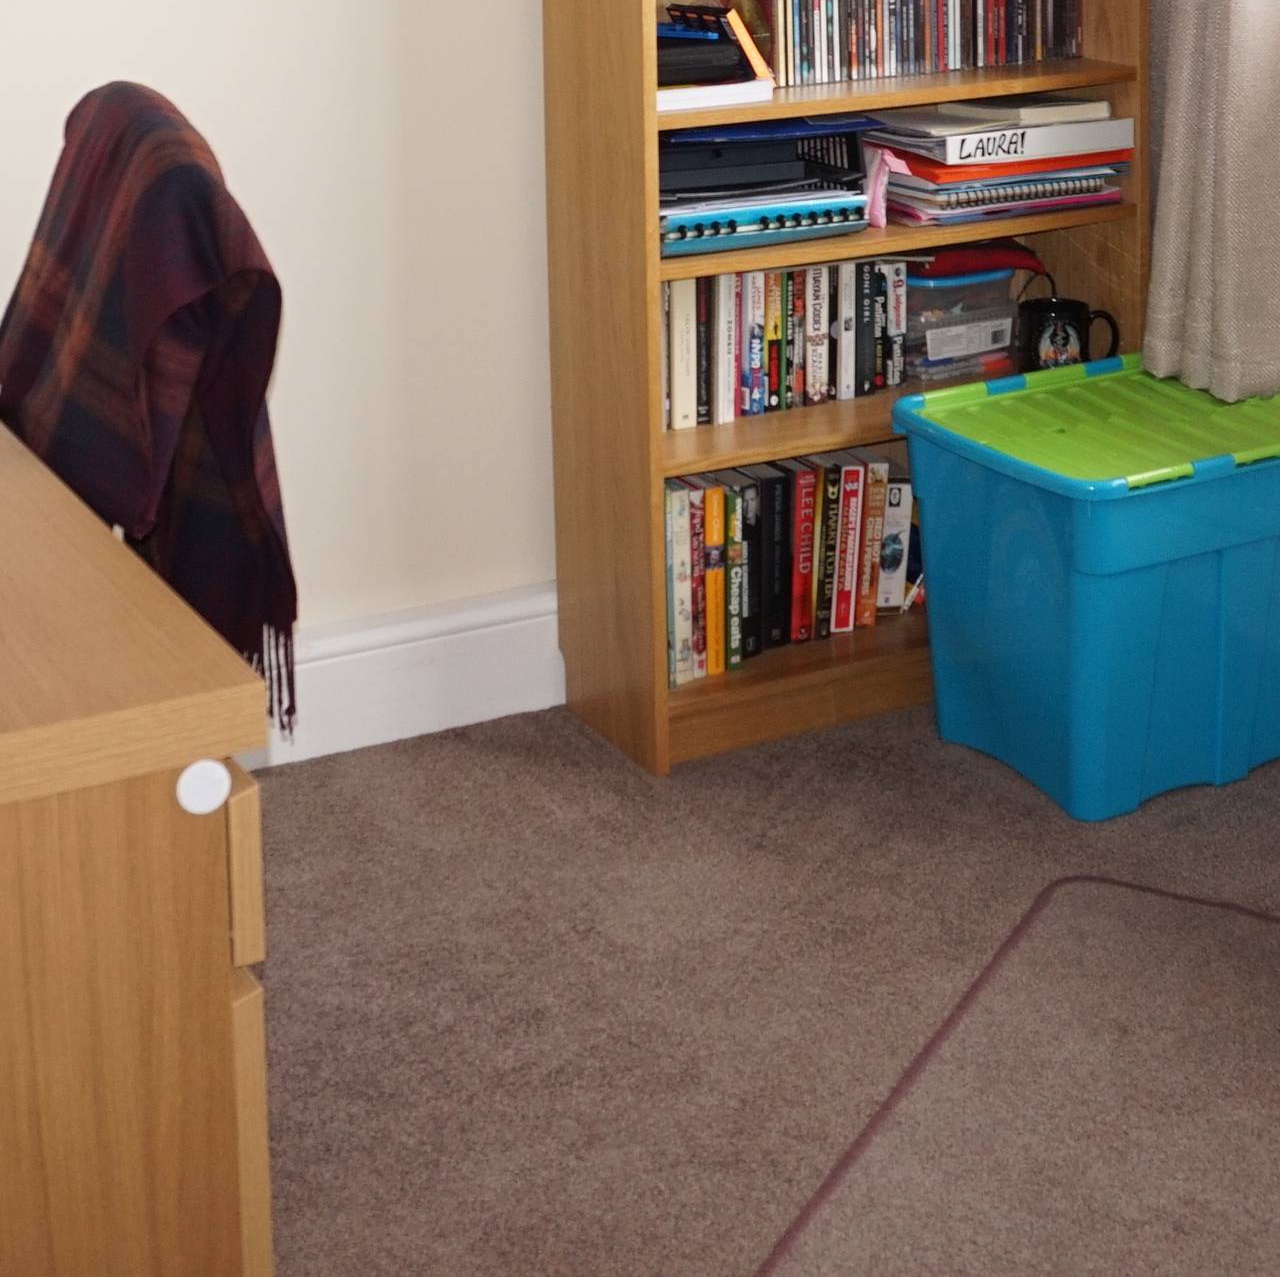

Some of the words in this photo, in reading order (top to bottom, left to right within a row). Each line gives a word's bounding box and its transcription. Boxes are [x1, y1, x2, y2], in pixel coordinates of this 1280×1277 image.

[959, 131, 1026, 160] LAURA!
[811, 268, 820, 301] MAYAN
[812, 303, 823, 332] CODEX
[874, 296, 885, 338] Patterson
[750, 339, 760, 368] NYPD
[893, 336, 902, 385] Patterson
[801, 488, 815, 518] LEE
[827, 504, 838, 546] HARRY
[864, 517, 874, 543] CHILI
[873, 518, 883, 540] RED
[799, 522, 815, 574] CHILD
[872, 542, 880, 562] HOT
[823, 552, 835, 599] POTTER
[861, 544, 872, 596] PEPPERS
[728, 567, 742, 614] Cheap
[731, 617, 741, 649] eats
